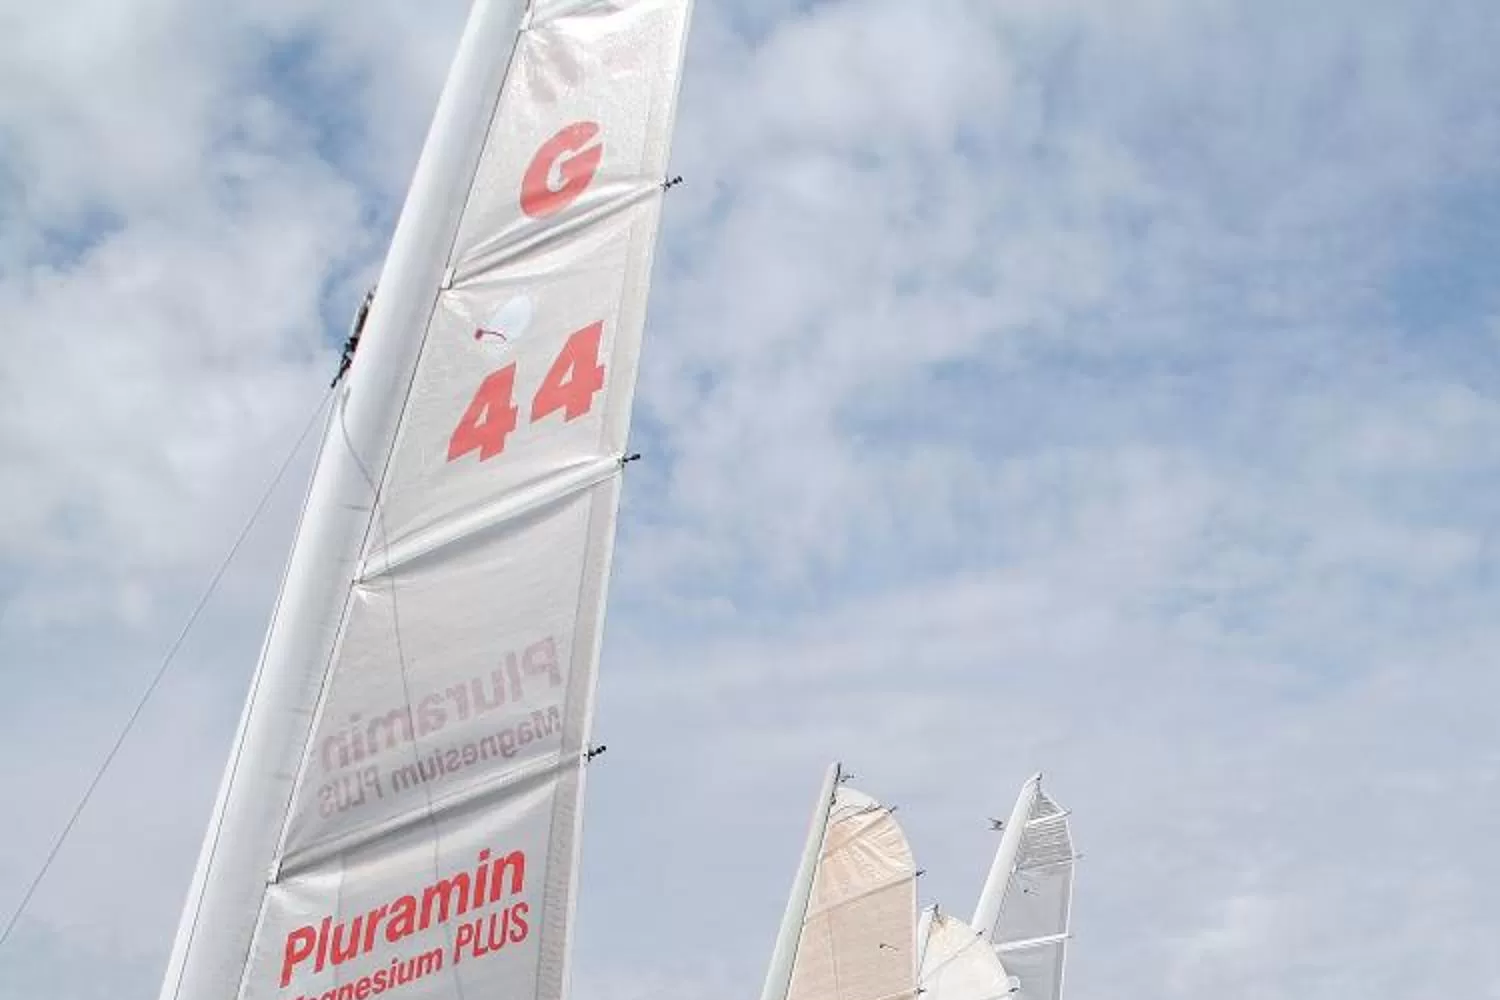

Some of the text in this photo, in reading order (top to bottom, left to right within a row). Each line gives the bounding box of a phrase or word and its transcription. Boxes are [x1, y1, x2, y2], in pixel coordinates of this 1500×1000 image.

[521, 121, 603, 219] G
[446, 320, 605, 462] 44
[279, 848, 525, 988] Pluramin
[452, 902, 529, 965] PLUS
